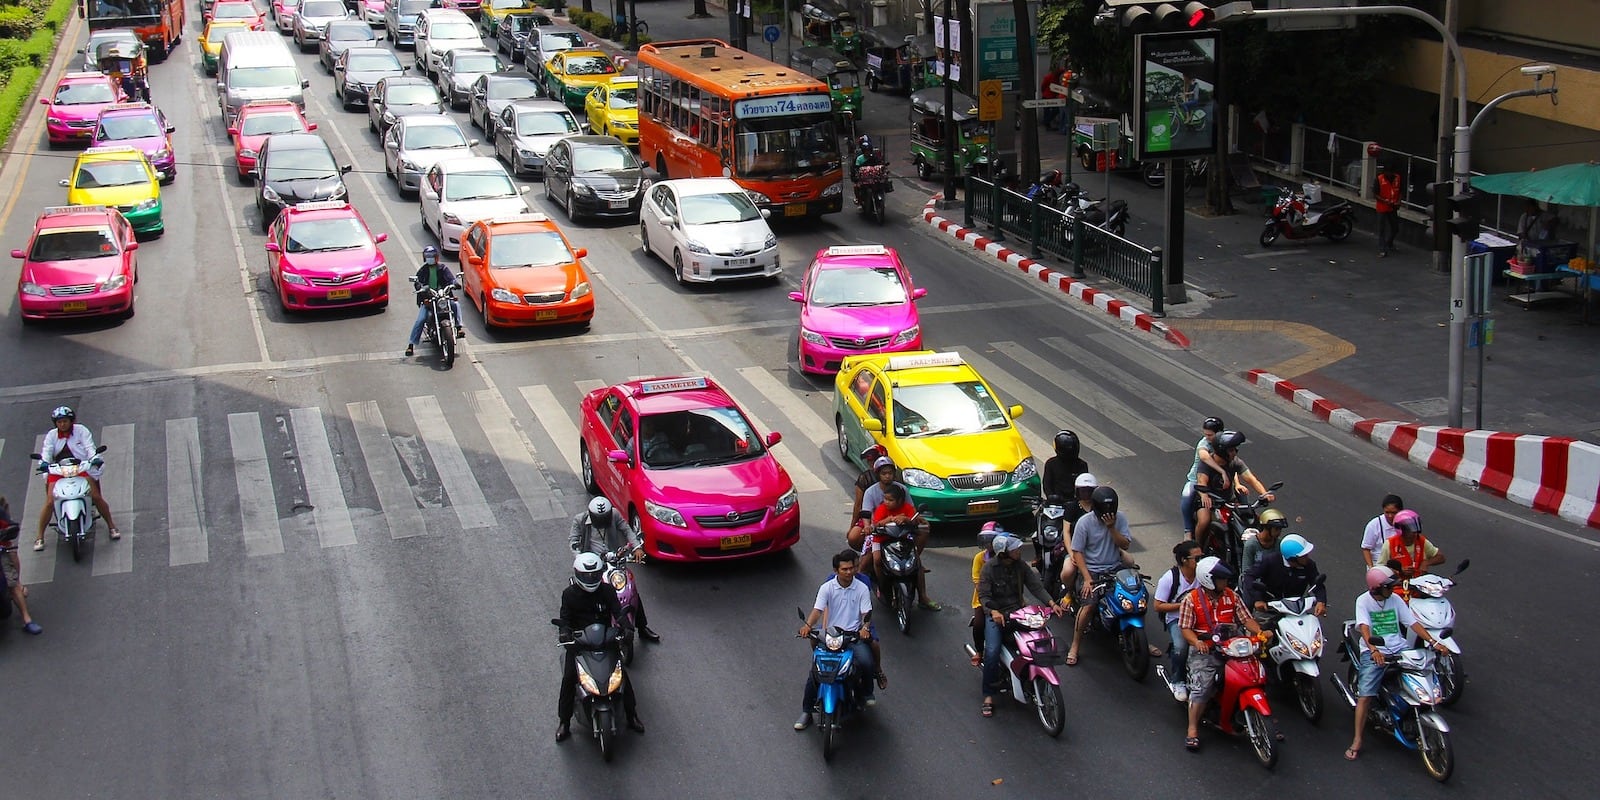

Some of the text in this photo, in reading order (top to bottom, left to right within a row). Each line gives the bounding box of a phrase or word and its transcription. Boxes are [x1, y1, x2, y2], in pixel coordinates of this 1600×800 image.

[742, 100, 830, 115] ห้วยขวาง 74 คลองเตย
[1453, 299, 1463, 308] 10
